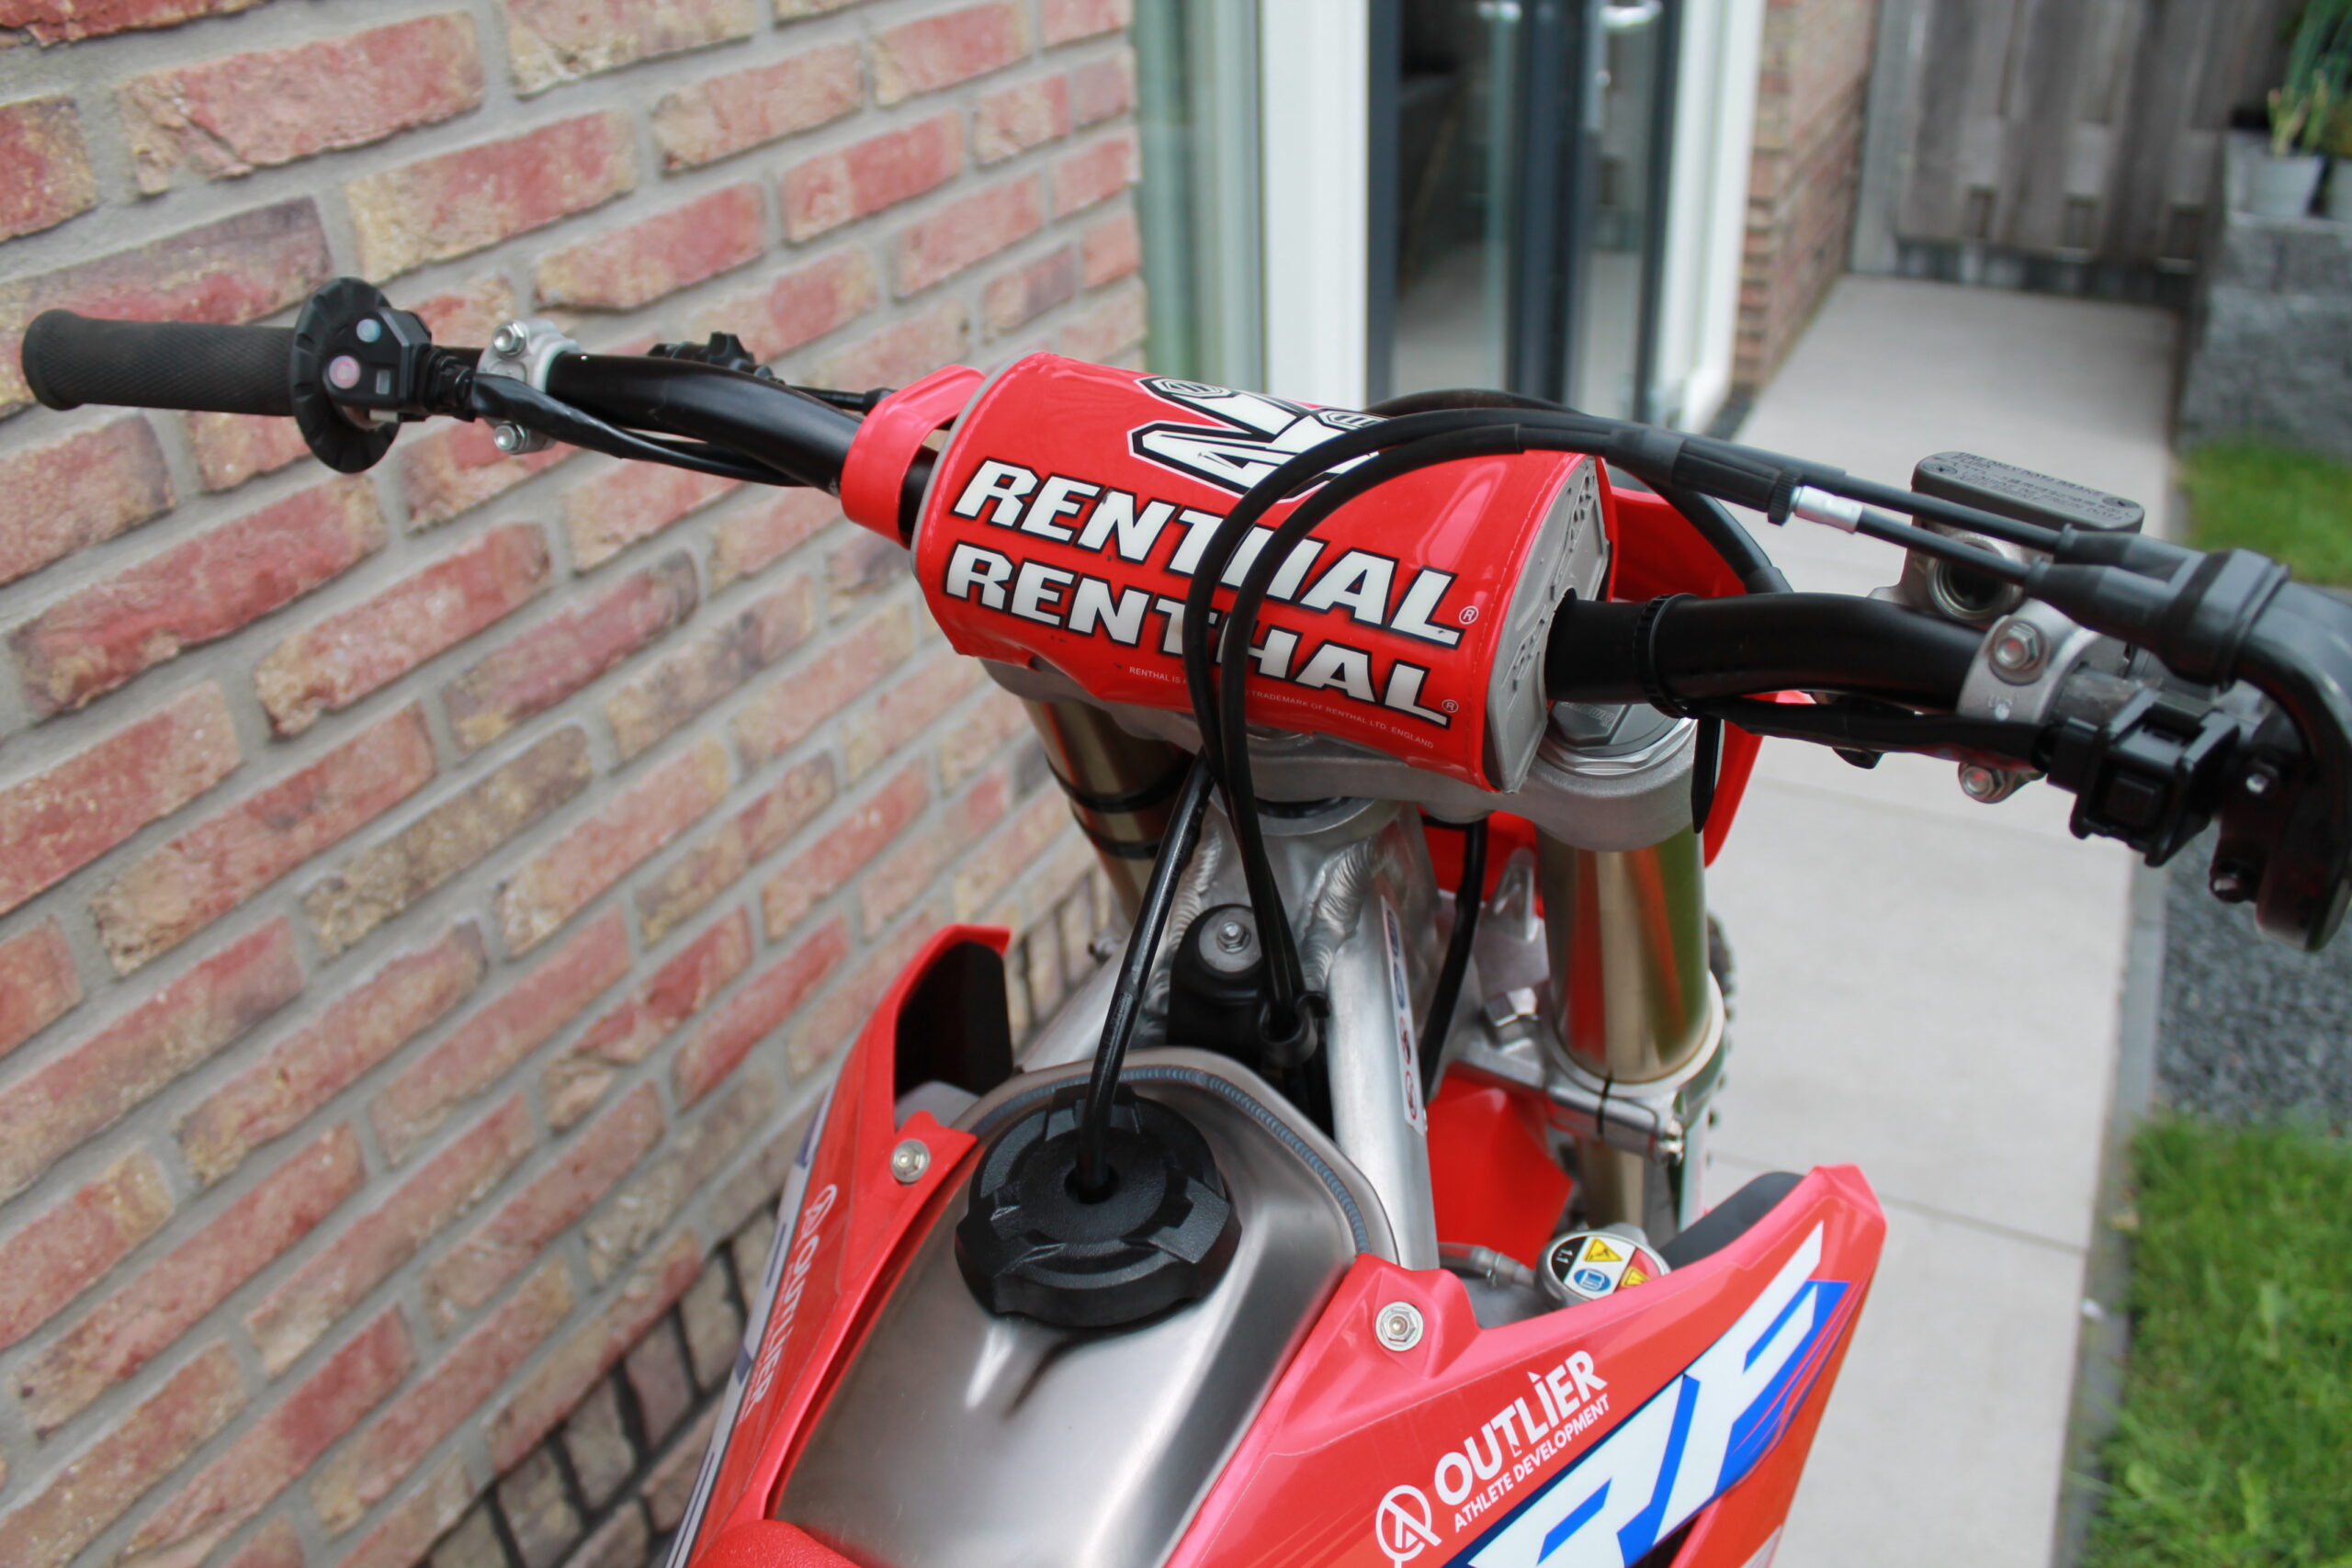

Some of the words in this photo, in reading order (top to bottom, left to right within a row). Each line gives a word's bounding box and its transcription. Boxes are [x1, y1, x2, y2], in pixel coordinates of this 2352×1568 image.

[1129, 666, 1169, 682] RENTHAL
[1251, 690, 1308, 707] TRADEMARK
[1326, 706, 1366, 724] RENTHAL
[1391, 727, 1434, 749] ENGLAND
[1434, 1350, 1608, 1506] OUTLIER
[1455, 1472, 1514, 1533] ATHLETE
[1513, 1393, 1611, 1483] DEVELOPMENT
